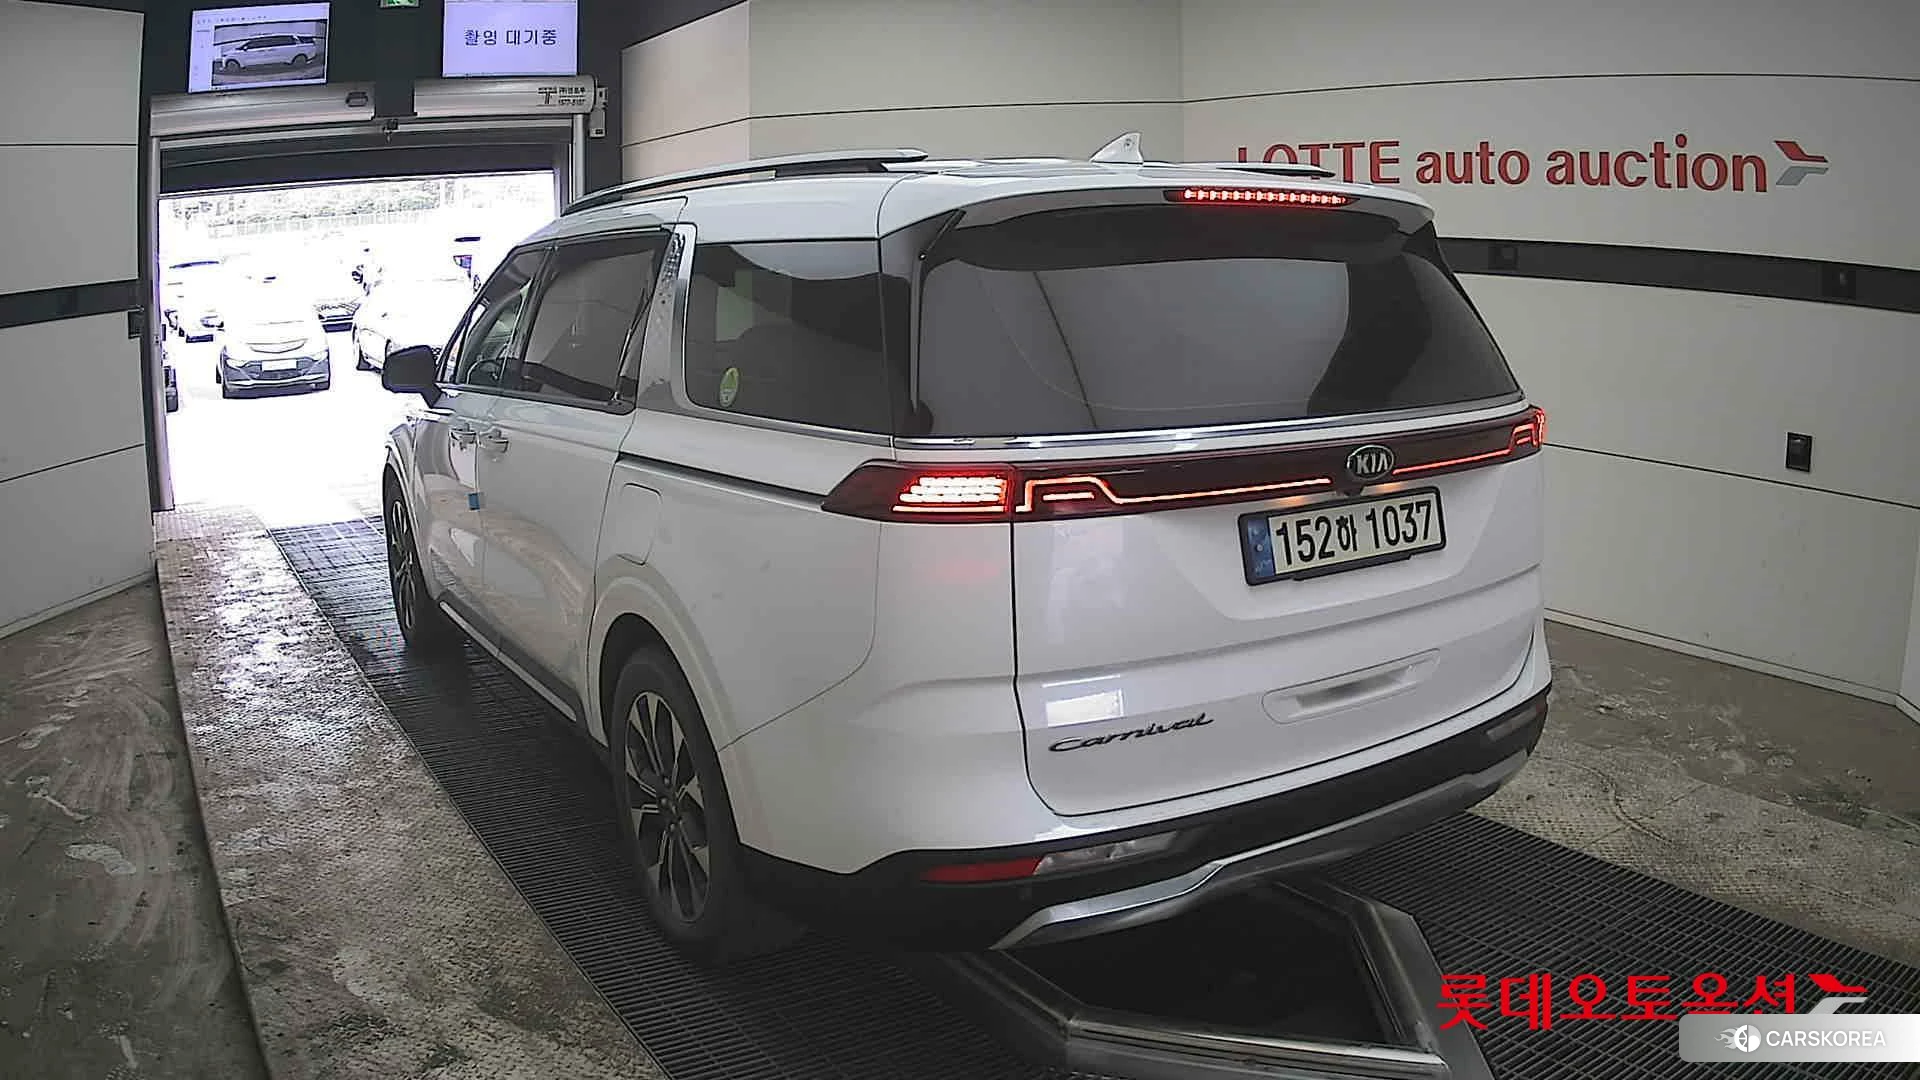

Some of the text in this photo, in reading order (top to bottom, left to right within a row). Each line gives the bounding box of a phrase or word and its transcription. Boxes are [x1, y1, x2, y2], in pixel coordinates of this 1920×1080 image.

[506, 29, 557, 46] 대기중
[1415, 140, 1530, 185] auto
[1545, 133, 1768, 193] auction
[1355, 452, 1389, 475] KIA
[1275, 499, 1432, 566] 152하 1037
[1049, 712, 1214, 752] Carnival
